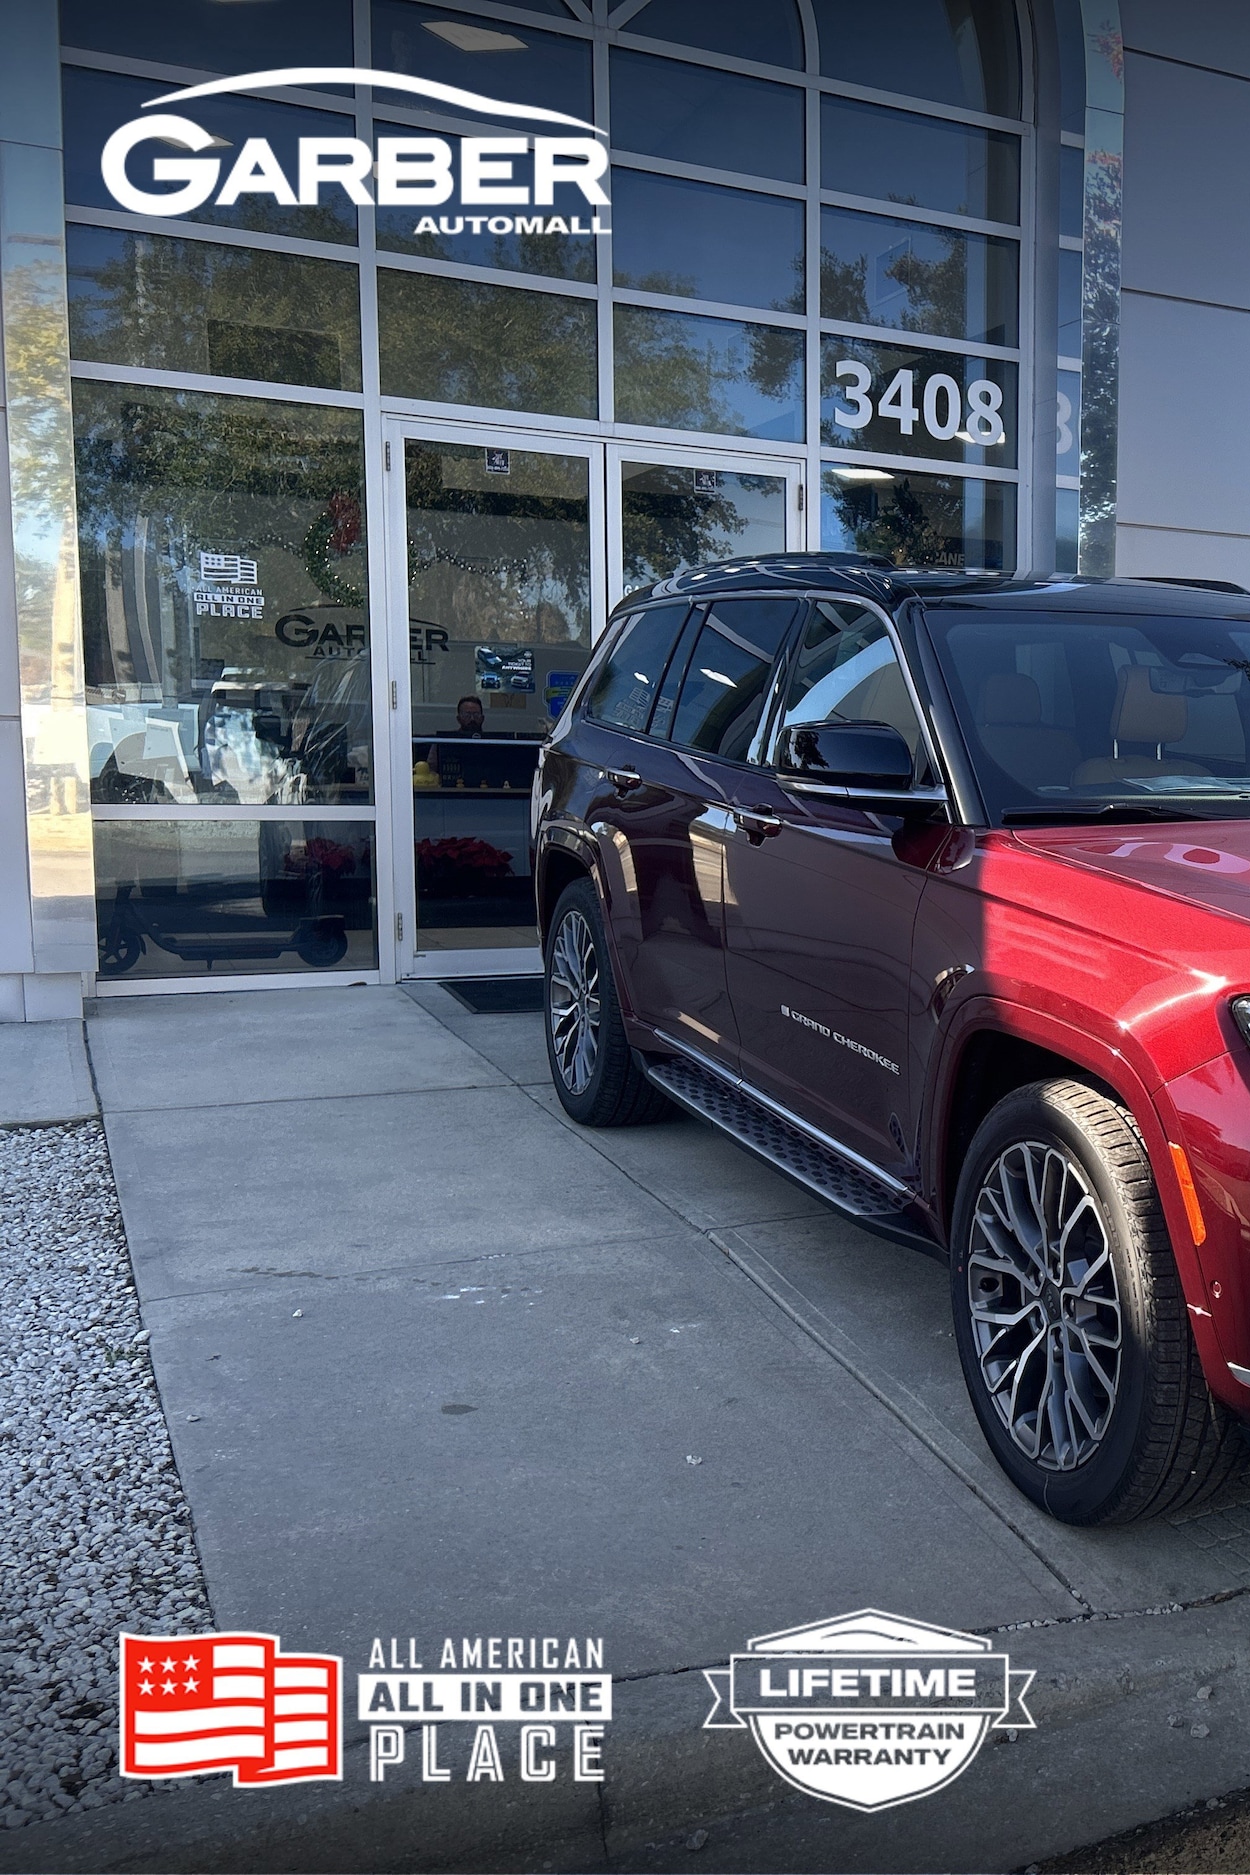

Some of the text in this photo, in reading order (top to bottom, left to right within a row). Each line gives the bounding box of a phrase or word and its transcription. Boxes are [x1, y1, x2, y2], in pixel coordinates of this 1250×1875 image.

[834, 359, 1004, 446] 3408
[216, 587, 262, 595] AMERICAN
[196, 603, 263, 619] PLACE
[275, 614, 449, 651] GARER
[791, 1010, 900, 1075] GRAND CHEROKEE
